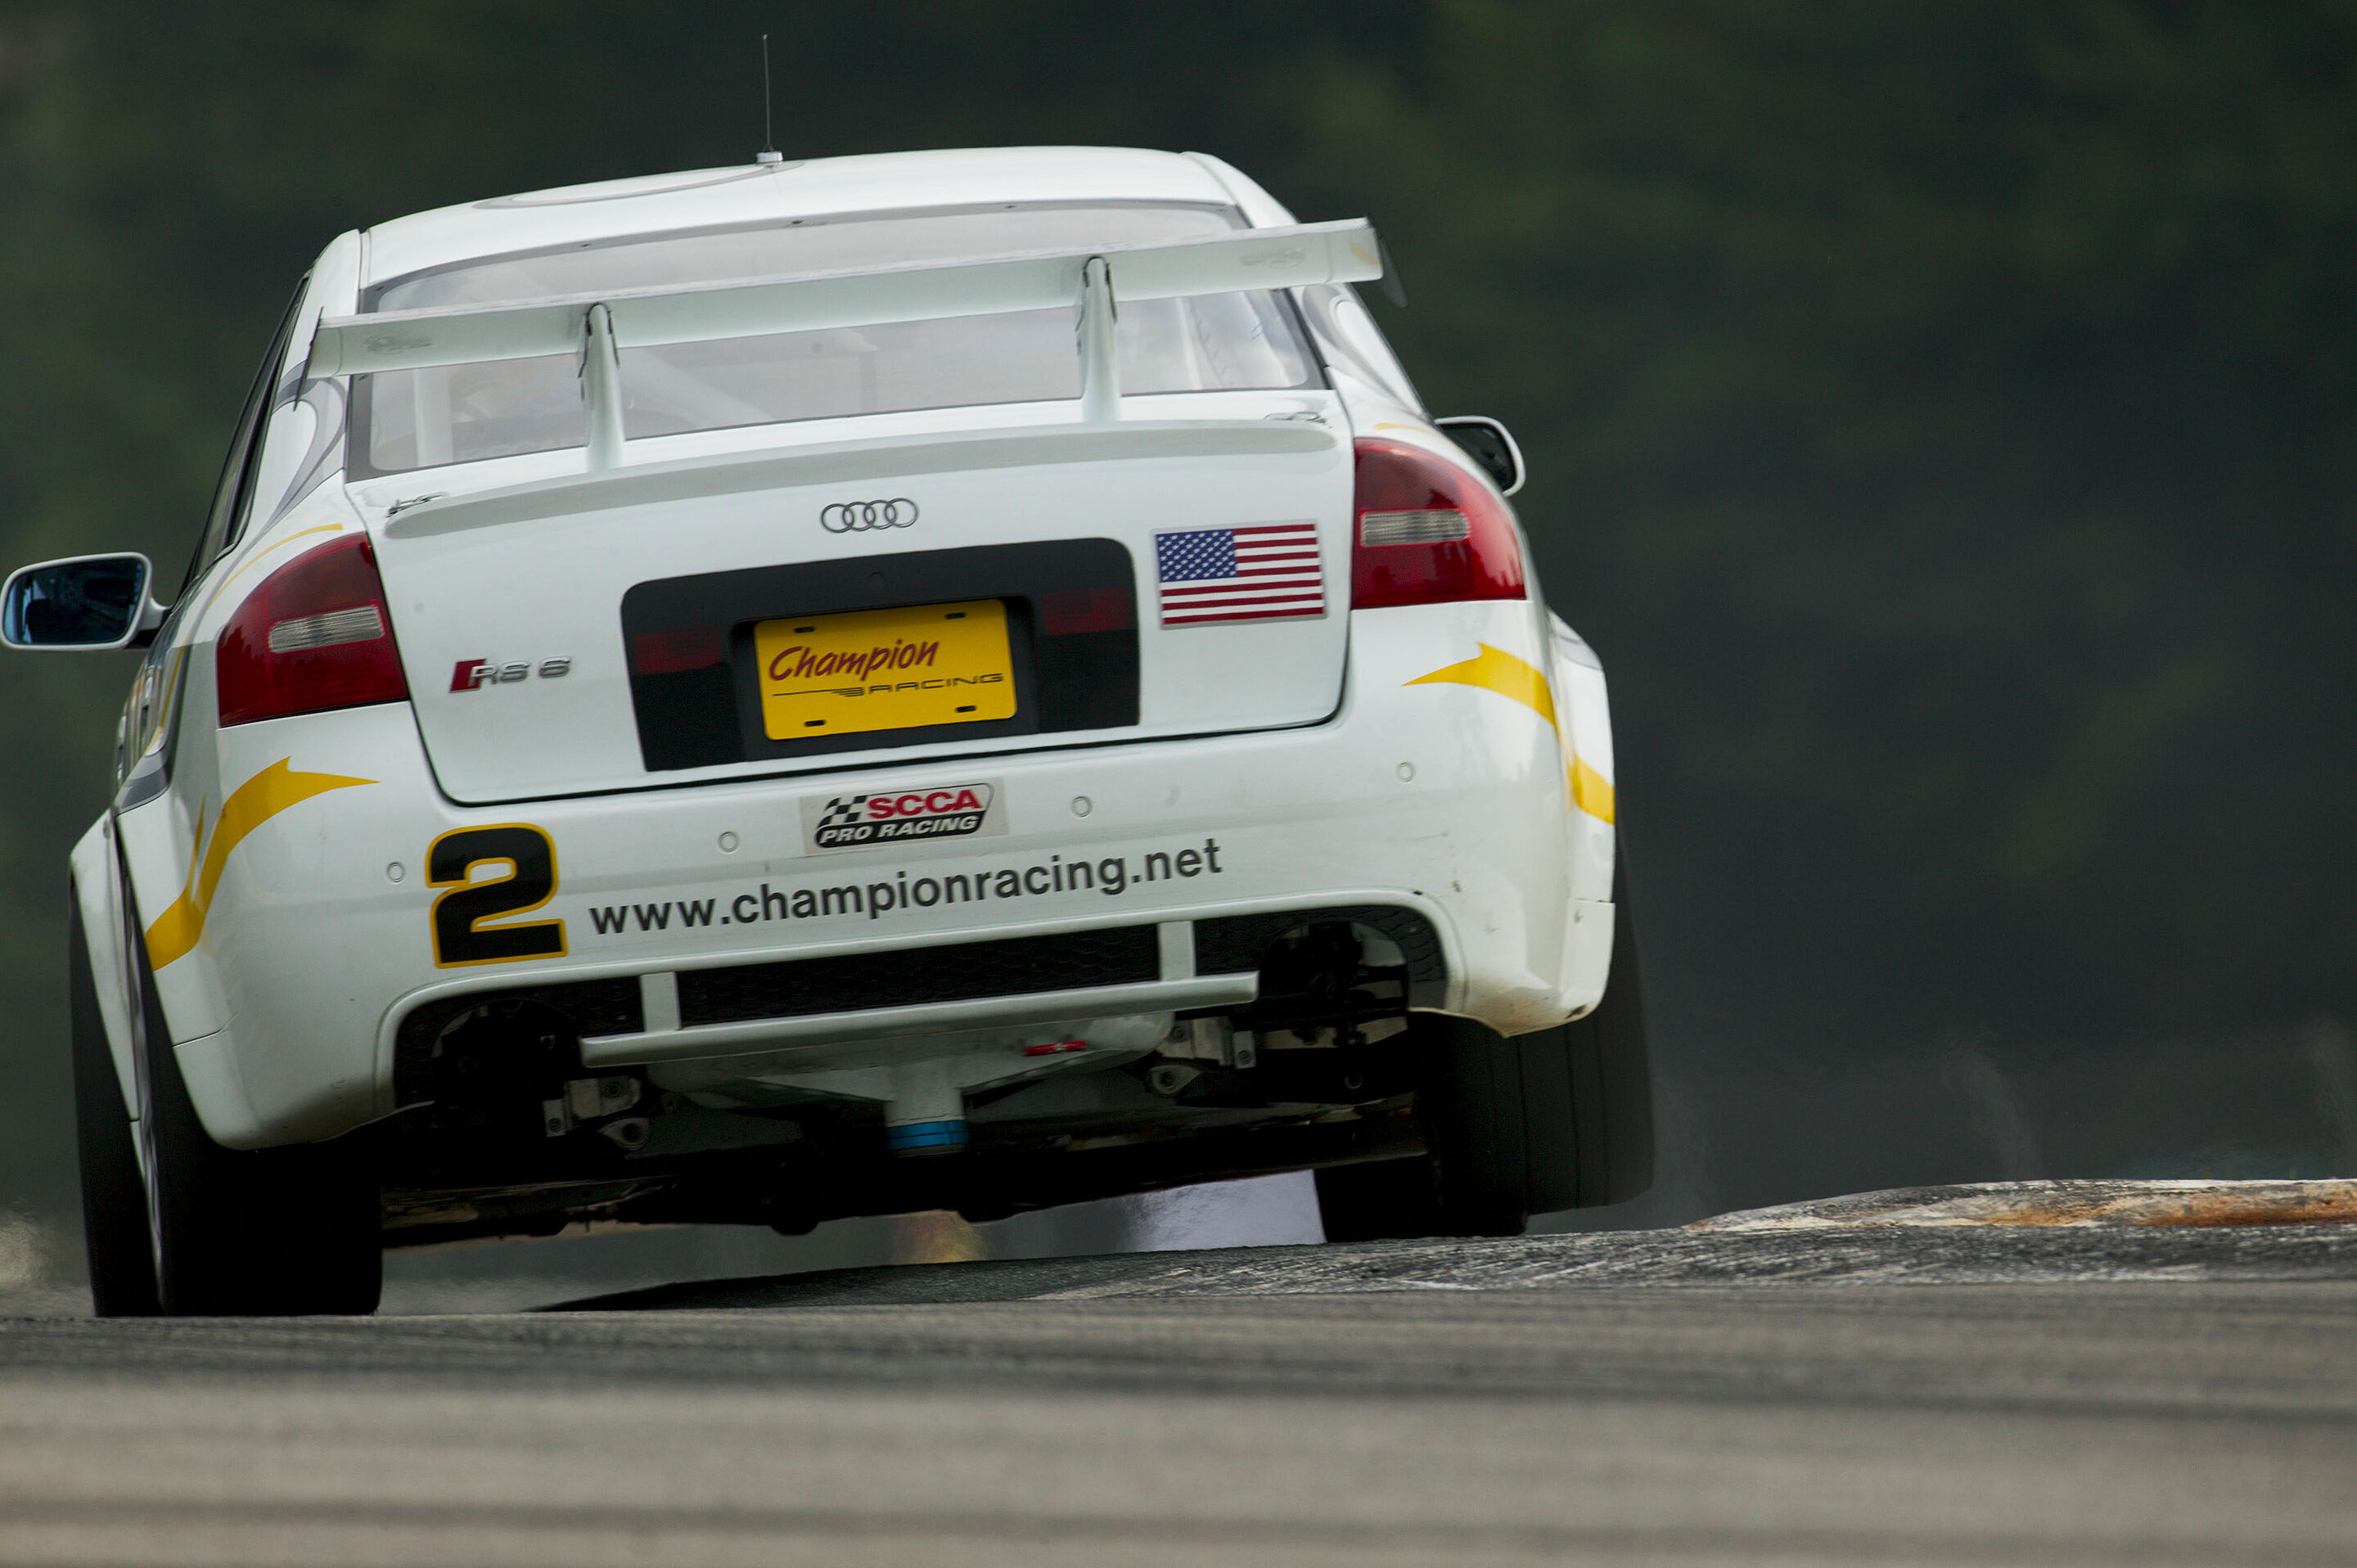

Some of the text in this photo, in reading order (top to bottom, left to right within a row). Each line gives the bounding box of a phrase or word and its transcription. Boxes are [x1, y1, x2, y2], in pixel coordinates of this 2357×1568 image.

[467, 656, 572, 686] RS 6
[768, 639, 940, 682] Champion
[868, 673, 1003, 695] RACING
[868, 790, 982, 819] SCCA
[818, 815, 979, 844] PRO RACING
[426, 822, 568, 969] 2
[589, 838, 1223, 935] www.championracing.net
